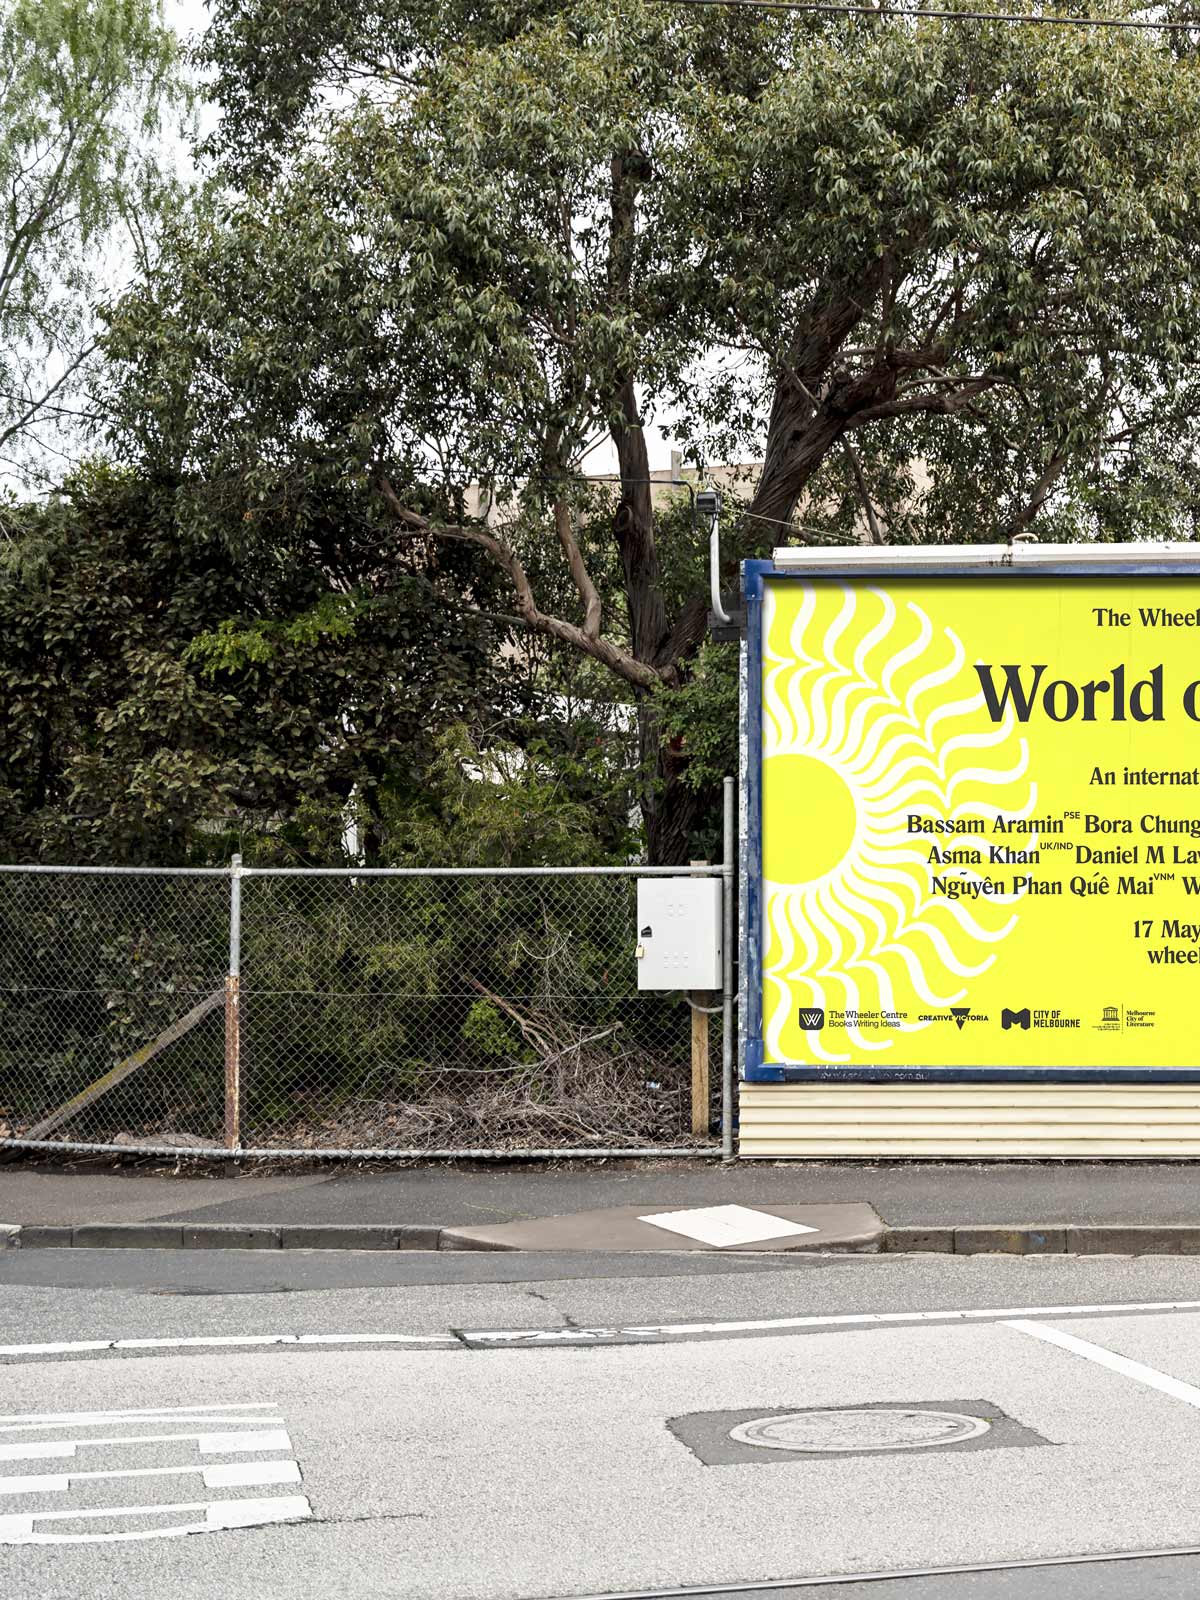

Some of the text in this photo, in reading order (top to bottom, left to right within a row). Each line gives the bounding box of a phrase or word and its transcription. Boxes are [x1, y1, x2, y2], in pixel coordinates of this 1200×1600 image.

[1092, 608, 1131, 626] The
[973, 664, 1165, 722] World
[1090, 767, 1115, 785] An
[907, 815, 984, 833] Bassam
[1085, 815, 1133, 833] Bora
[927, 846, 982, 864] Asma
[1076, 846, 1138, 864] Daniel
[1146, 846, 1165, 864] M
[1013, 876, 1062, 894] Phan
[1134, 920, 1153, 938] 17
[1034, 1010, 1061, 1018] CITY OF
[1034, 1019, 1080, 1027] MELBOURNE
[853, 1020, 879, 1029] Writing
